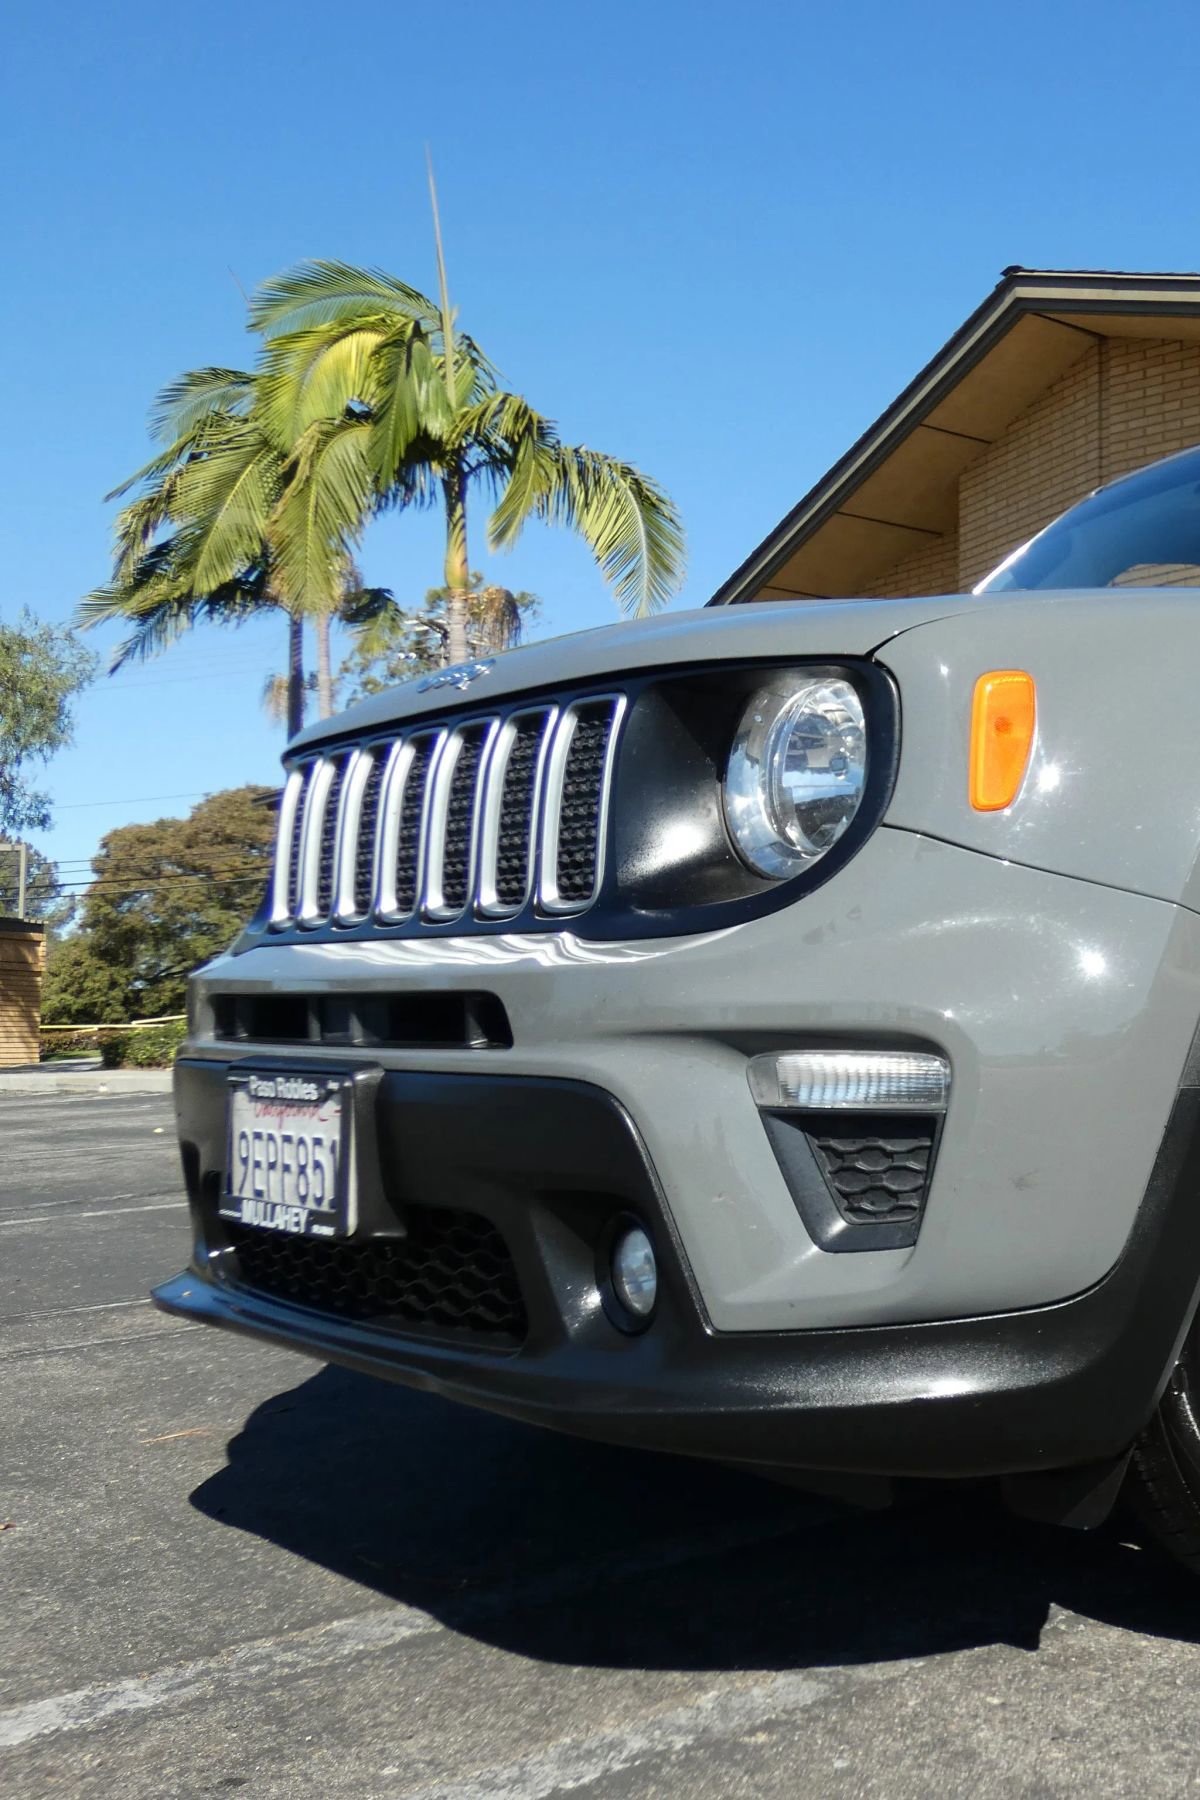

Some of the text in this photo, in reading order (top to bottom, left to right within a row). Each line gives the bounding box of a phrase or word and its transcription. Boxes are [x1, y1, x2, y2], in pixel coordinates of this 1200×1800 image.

[249, 1075, 275, 1098] Paso
[275, 1077, 319, 1101] Robles
[241, 1199, 309, 1234] MULLAHEY
